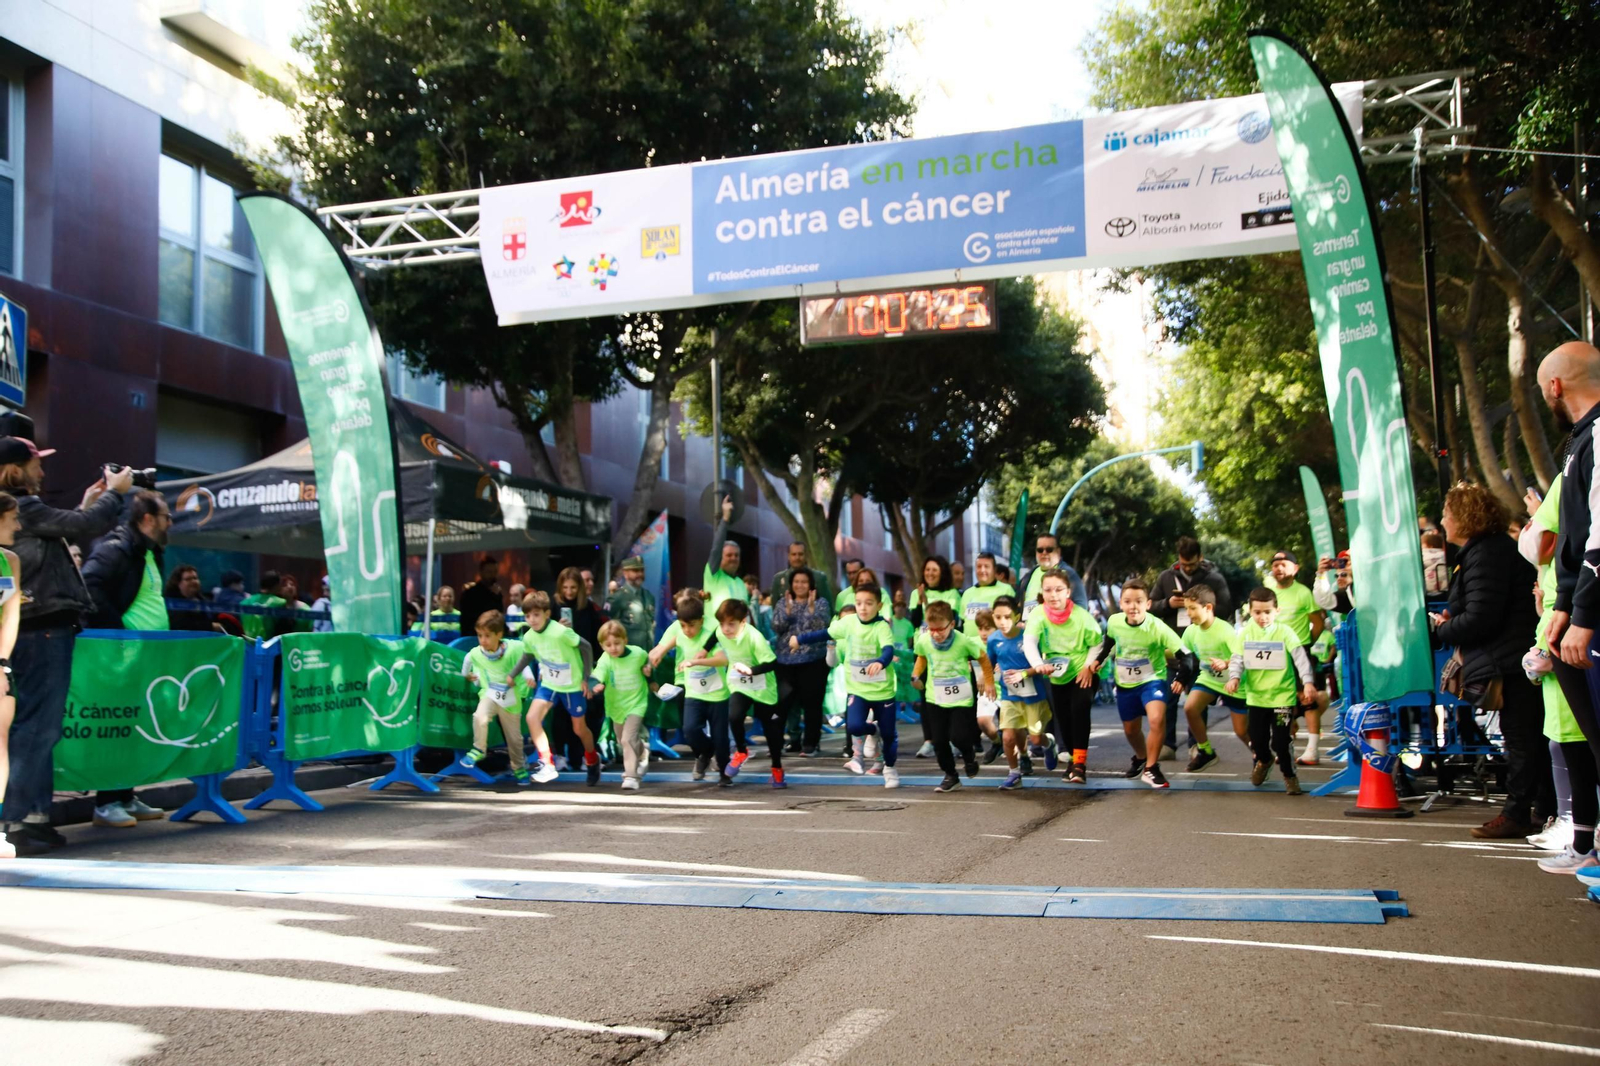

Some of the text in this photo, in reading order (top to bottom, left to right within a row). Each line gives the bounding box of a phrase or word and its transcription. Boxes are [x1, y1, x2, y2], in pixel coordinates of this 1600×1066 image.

[1133, 126, 1211, 147] cajamar
[715, 141, 1058, 204] Almería en marcha
[1136, 180, 1189, 192] MICHELIN
[715, 189, 1011, 243] contra el cáncer
[1142, 211, 1181, 223] Toyota
[994, 225, 1075, 241] asociación española
[1142, 220, 1224, 236] Alborán Motor
[995, 236, 1058, 249] contra el cáncer
[997, 250, 1007, 258] en
[707, 263, 820, 282] #TodosContraElCáncer
[218, 480, 318, 508] cruzandola
[1256, 650, 1272, 661] 47
[548, 668, 560, 679] 57
[1126, 666, 1142, 676] 75
[700, 678, 707, 687] 6
[944, 685, 960, 696] 58
[79, 702, 141, 719] cáncer
[96, 725, 132, 739] uno
